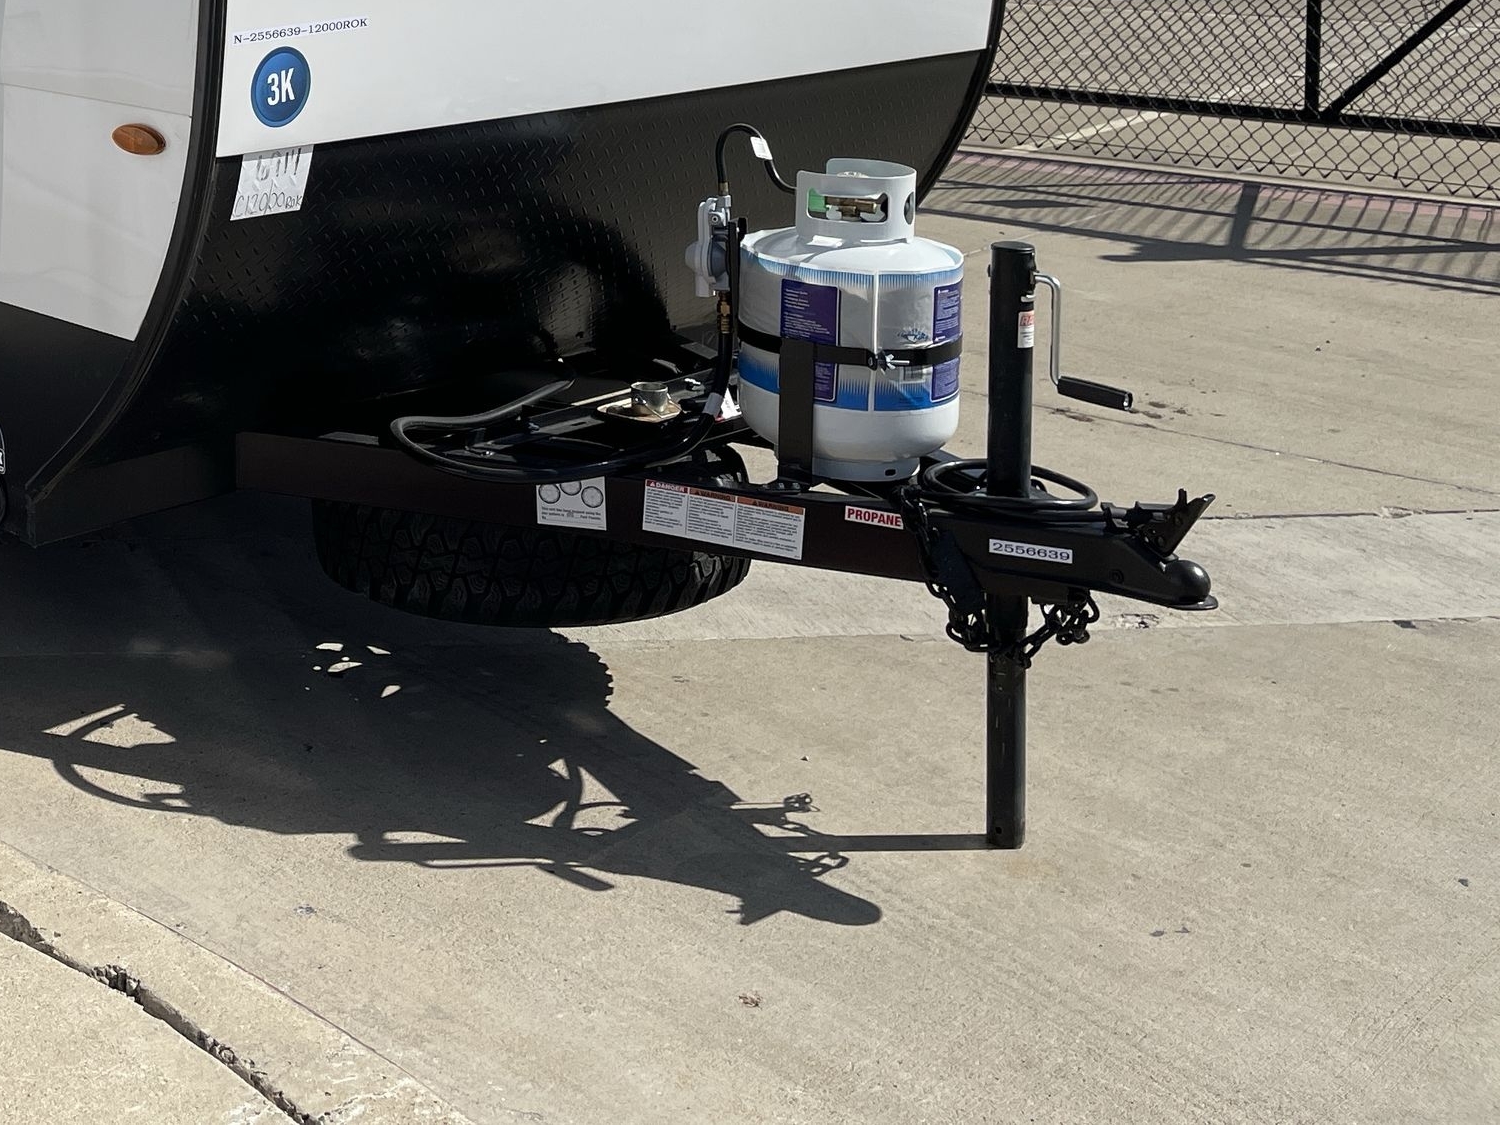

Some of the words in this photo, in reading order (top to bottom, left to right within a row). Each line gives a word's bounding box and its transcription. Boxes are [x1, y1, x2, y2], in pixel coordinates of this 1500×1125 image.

[233, 18, 368, 45] N-2556639-12000ROK
[267, 67, 295, 106] 3K
[847, 507, 901, 527] PROPANE
[993, 542, 1071, 561] 2556639
